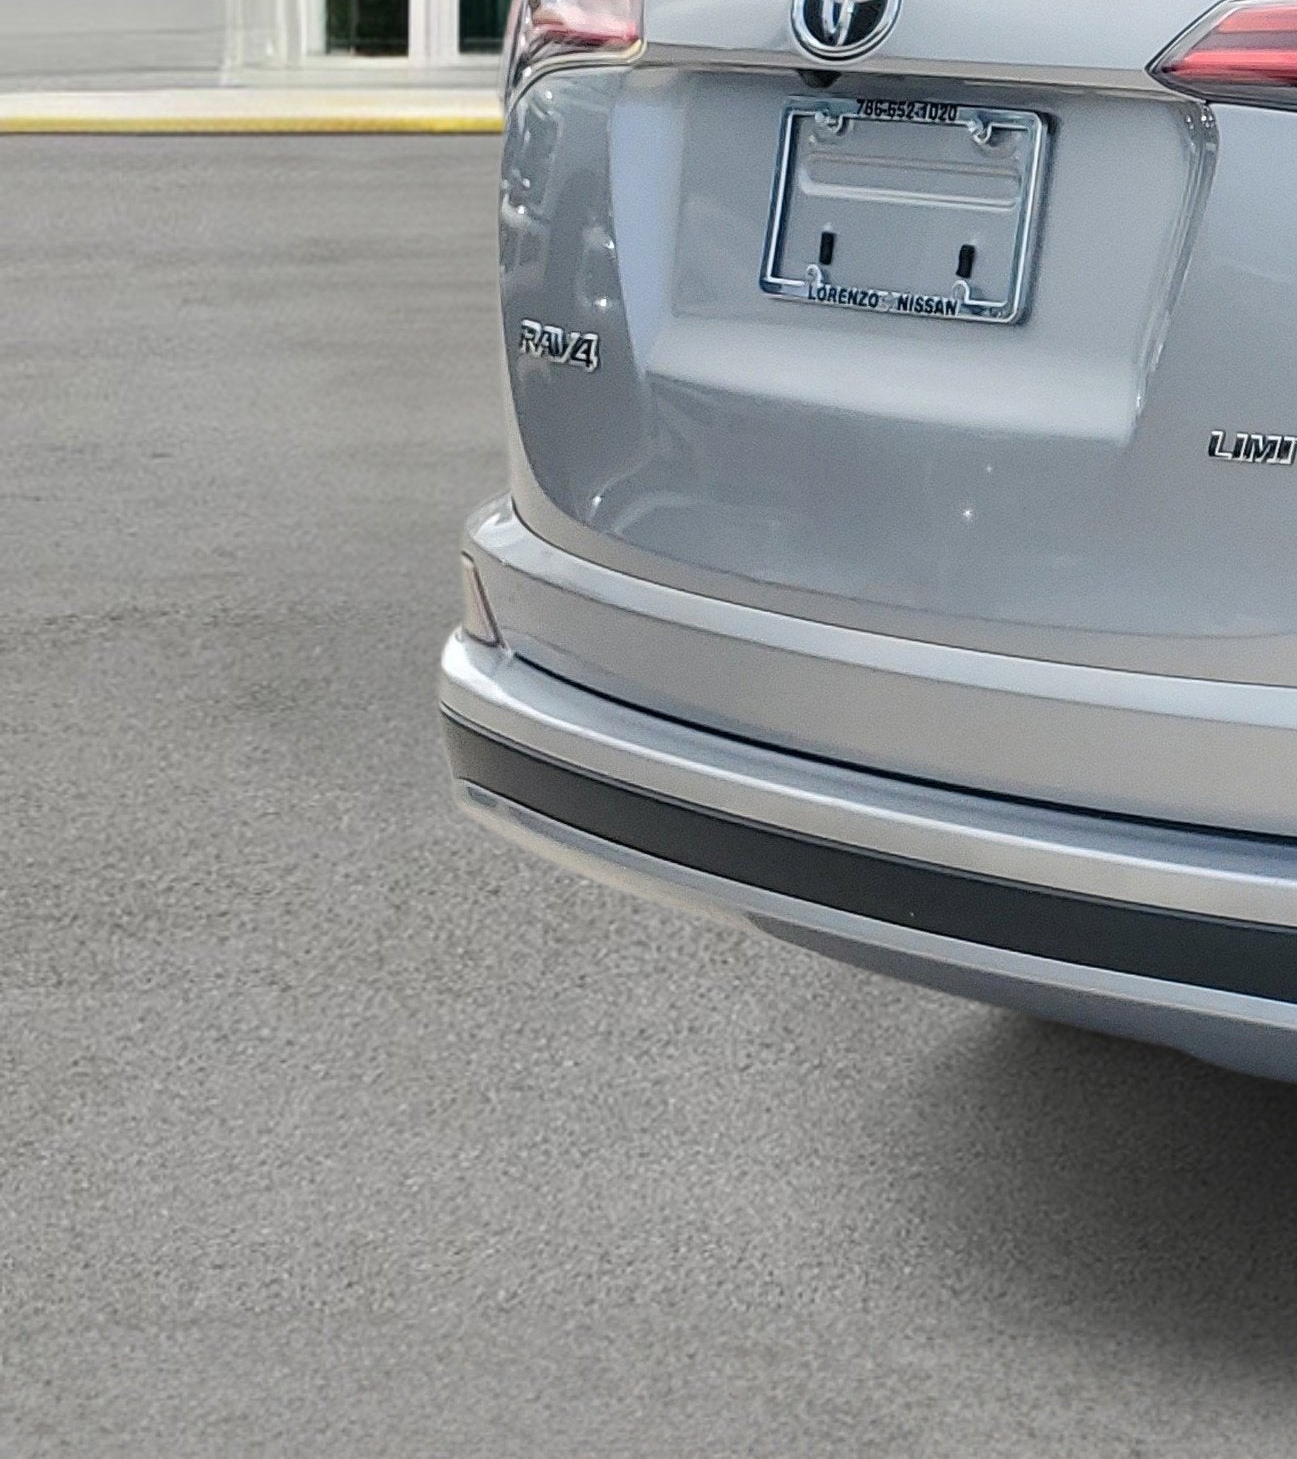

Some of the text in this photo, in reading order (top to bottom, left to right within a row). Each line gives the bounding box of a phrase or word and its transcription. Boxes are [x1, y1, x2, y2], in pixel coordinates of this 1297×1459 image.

[856, 98, 958, 122] 786-652-1020
[807, 283, 959, 316] LORENZO NISSAN
[519, 317, 600, 374] RAV4
